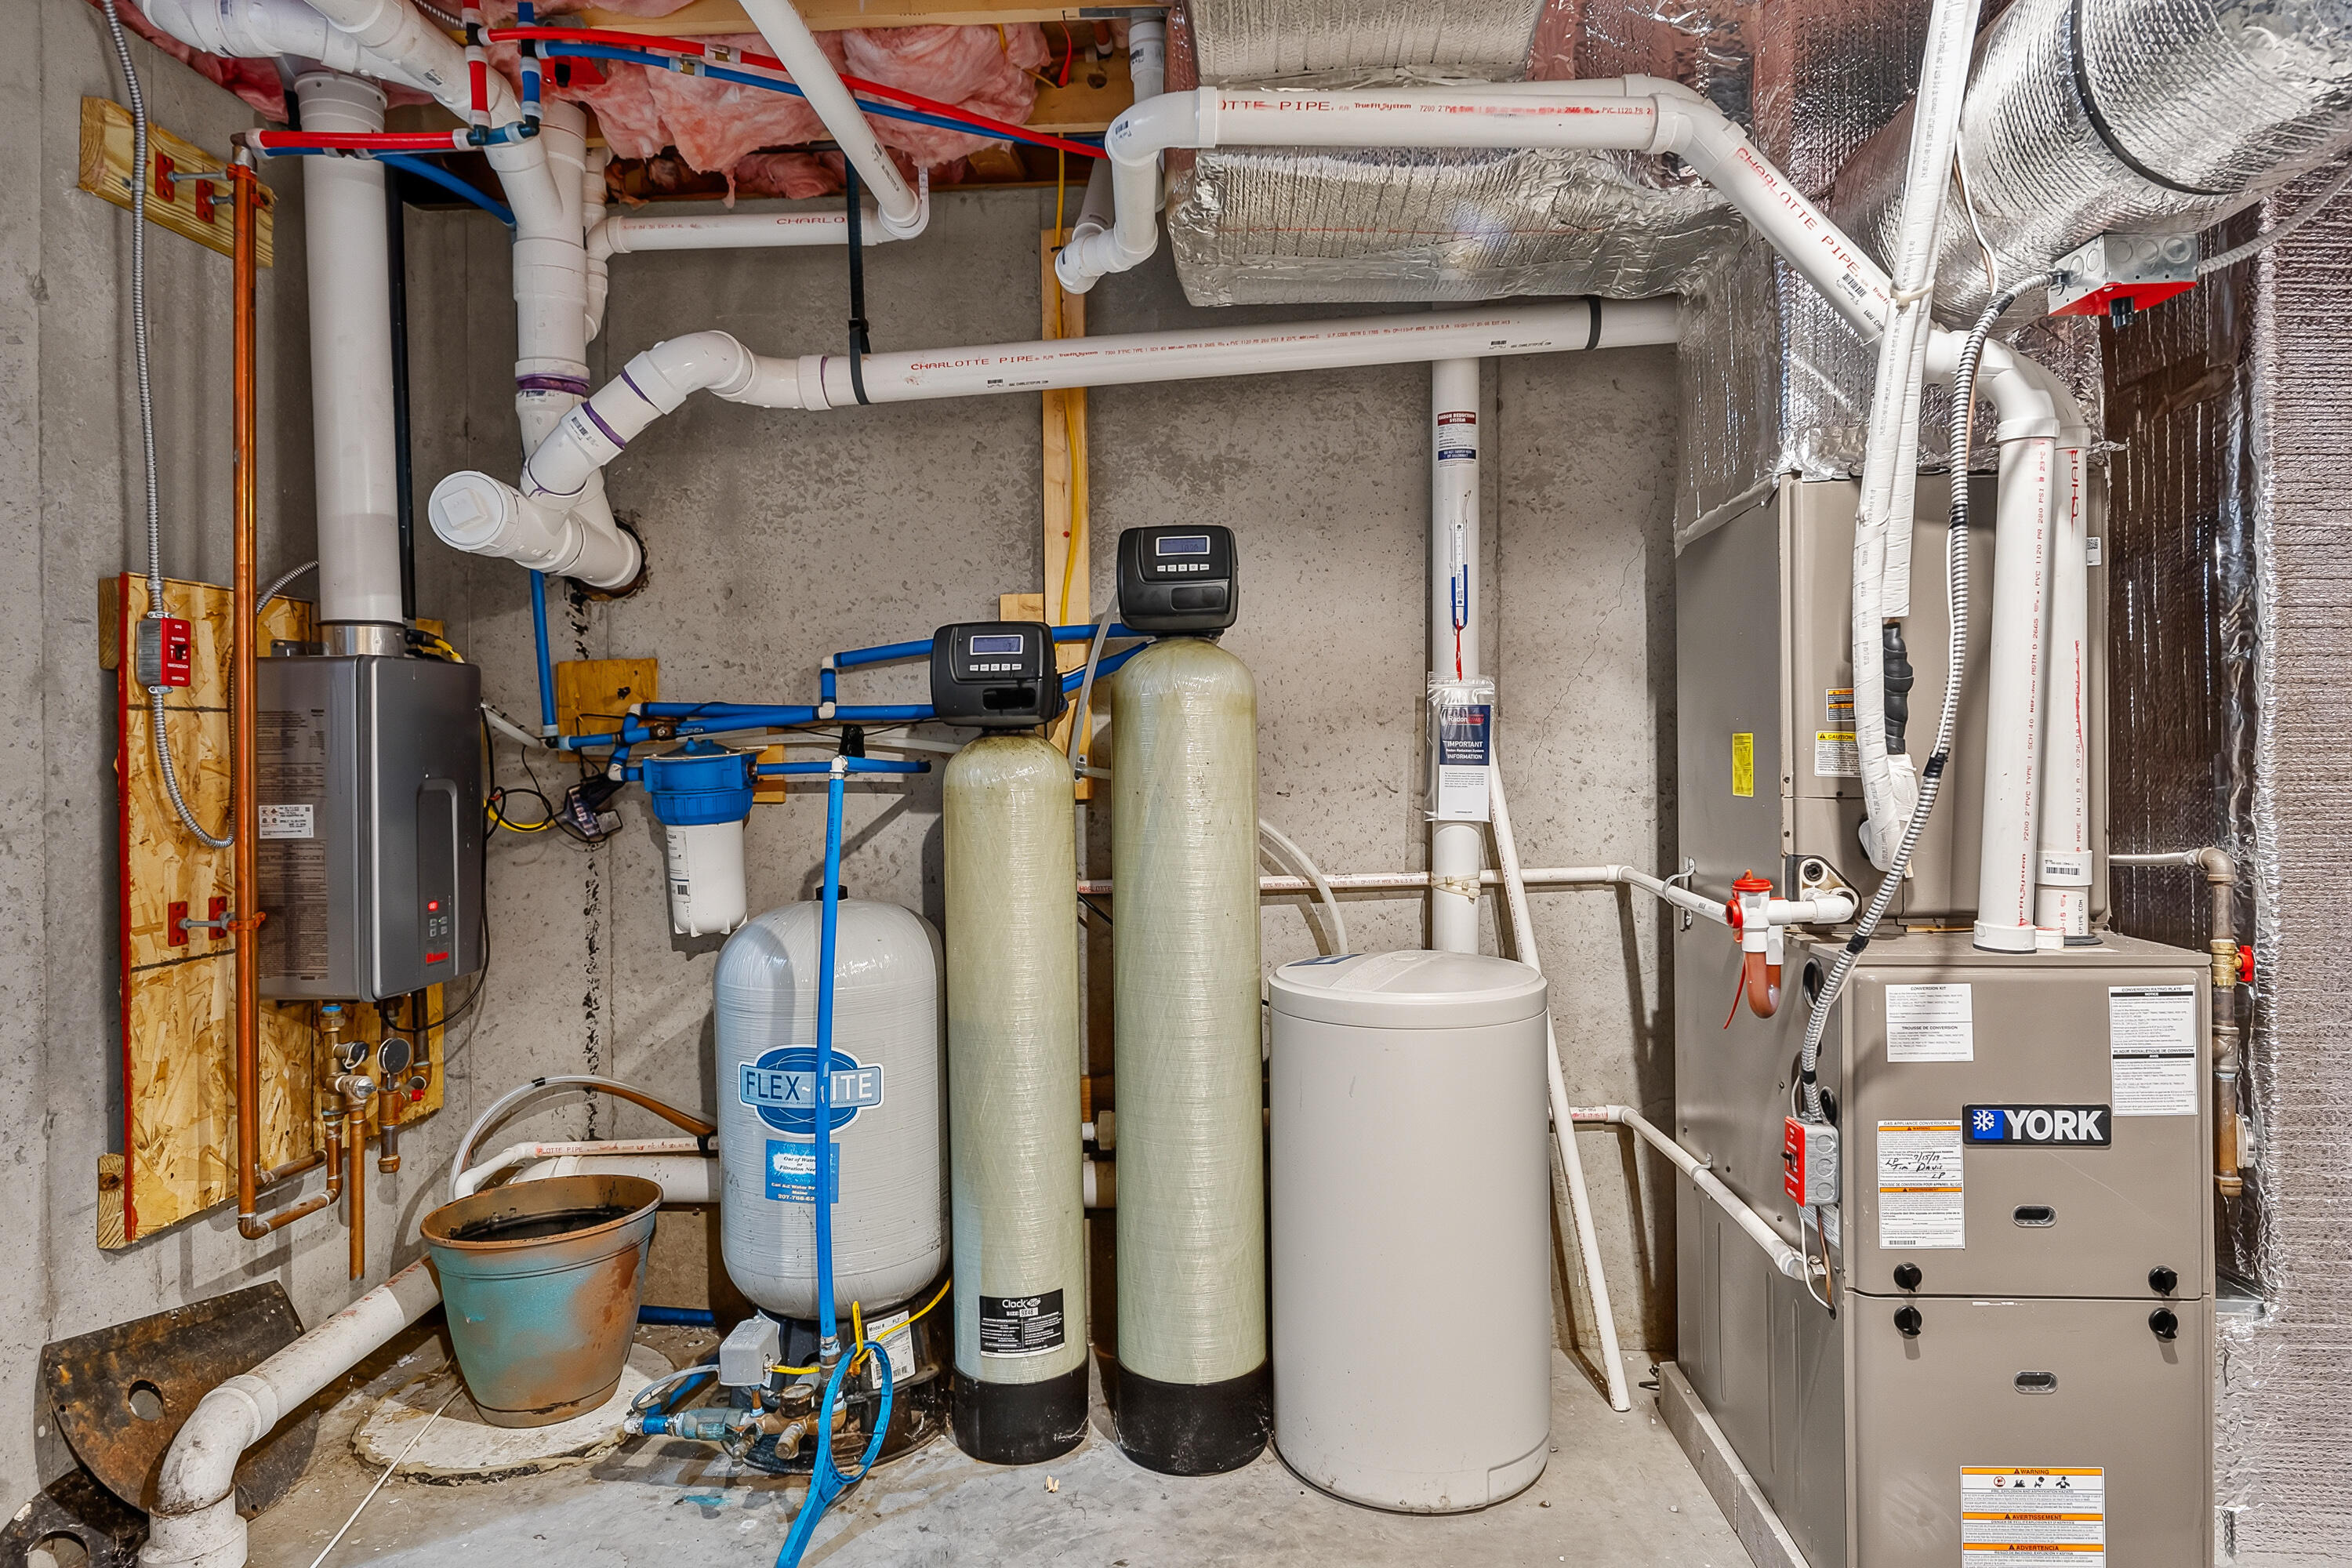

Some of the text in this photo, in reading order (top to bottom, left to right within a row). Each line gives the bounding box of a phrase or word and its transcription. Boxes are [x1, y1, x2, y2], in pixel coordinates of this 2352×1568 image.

[1279, 100, 1331, 111] PIPE
[1419, 104, 1436, 113] 7200
[1733, 146, 1818, 231] CHARLOTTE
[1820, 234, 1861, 275] PIPE
[775, 216, 847, 226] CHARLO
[910, 358, 990, 372] CHARLOTTE
[999, 354, 1034, 365] PIPE
[2037, 528, 2043, 539] PR
[2027, 718, 2034, 729] 40
[1446, 740, 1484, 749] IMPORTANT
[2003, 1109, 2104, 1141] YORK
[1001, 1298, 1028, 1310] Clack
